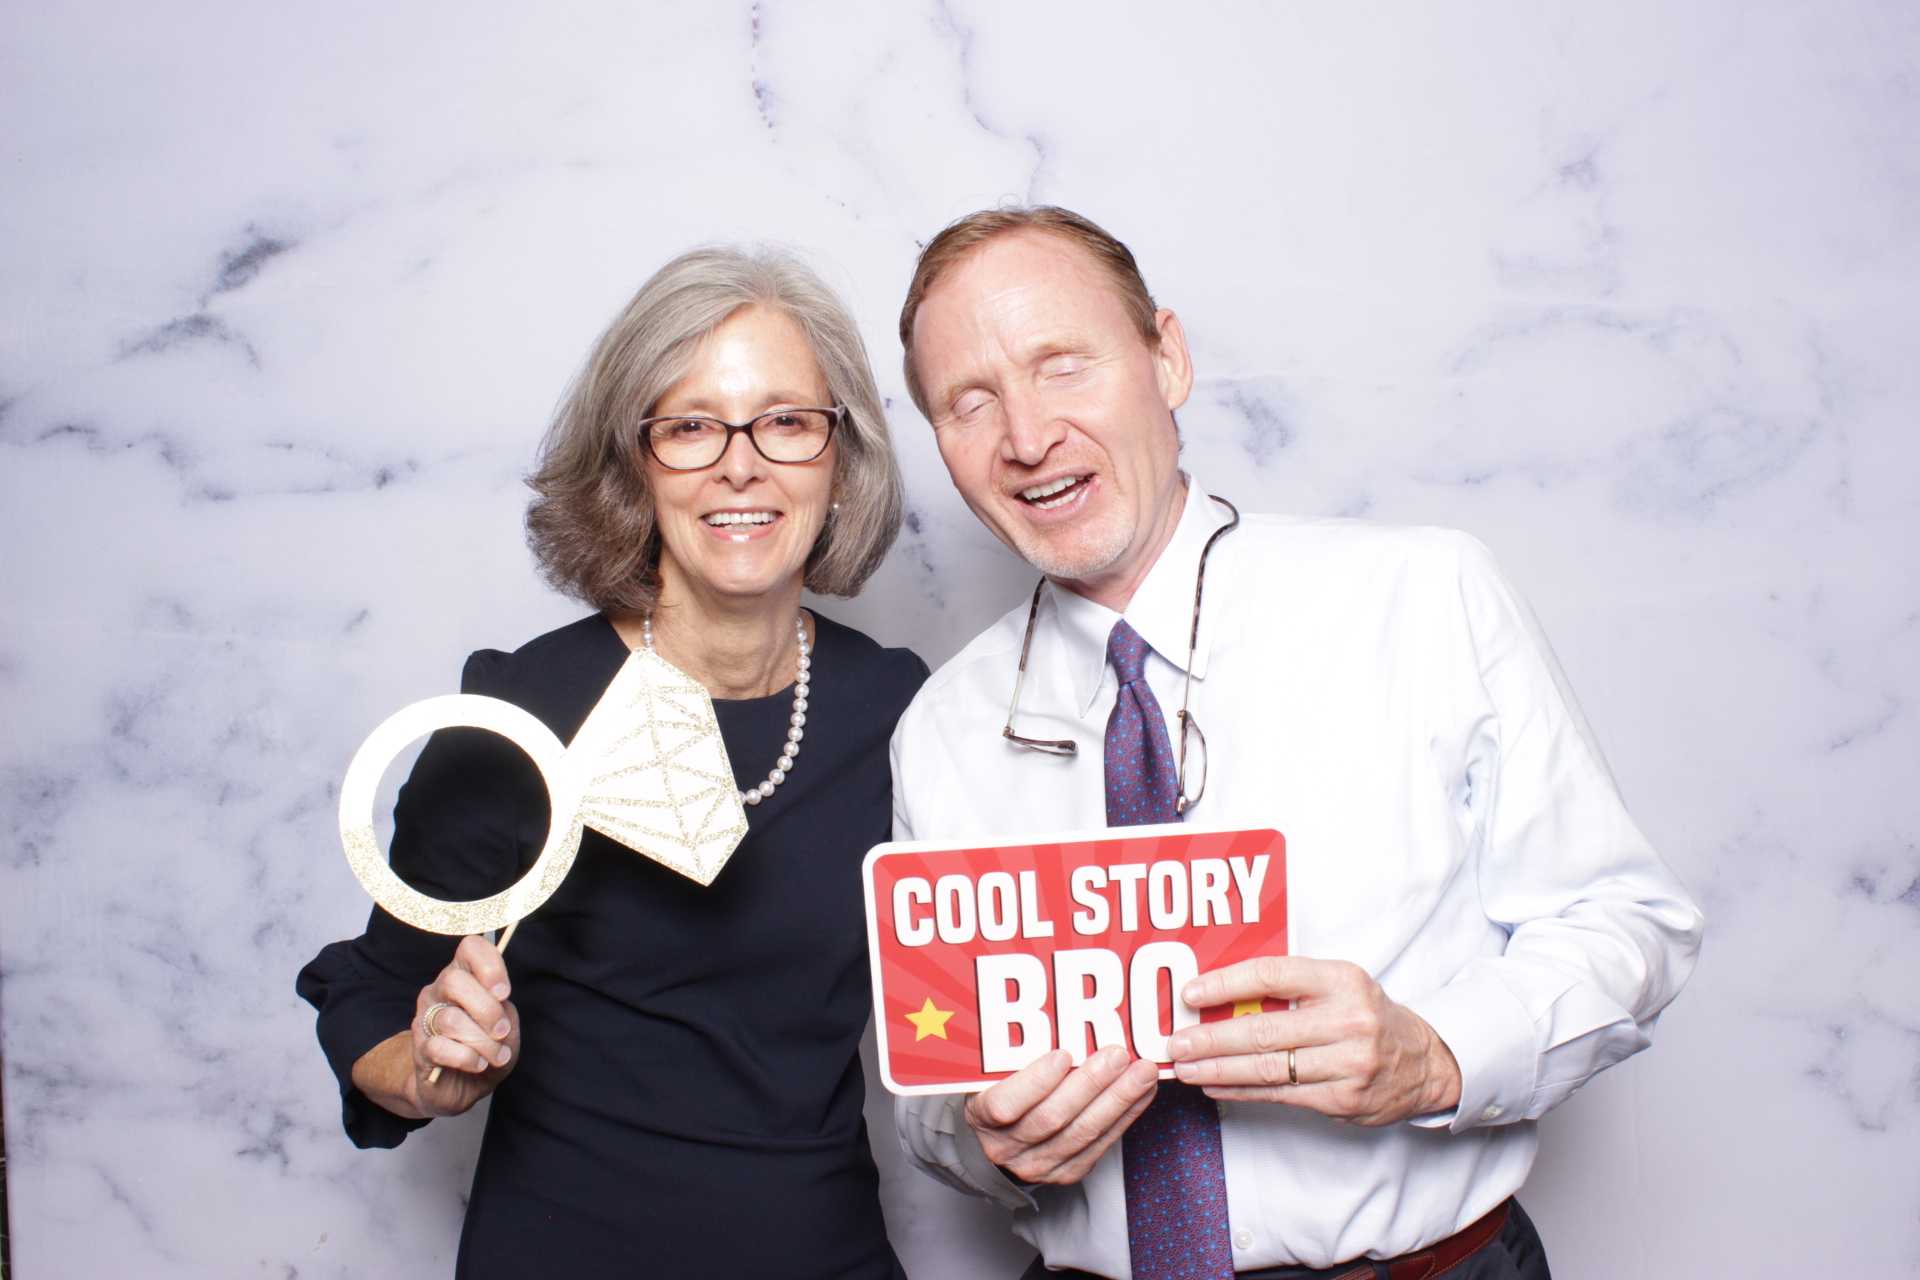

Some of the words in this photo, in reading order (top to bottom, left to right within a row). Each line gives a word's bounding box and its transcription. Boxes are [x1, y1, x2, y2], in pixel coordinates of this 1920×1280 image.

[892, 870, 1054, 947] COOL
[1070, 854, 1270, 936] STORY
[975, 941, 1200, 1073] BRO
